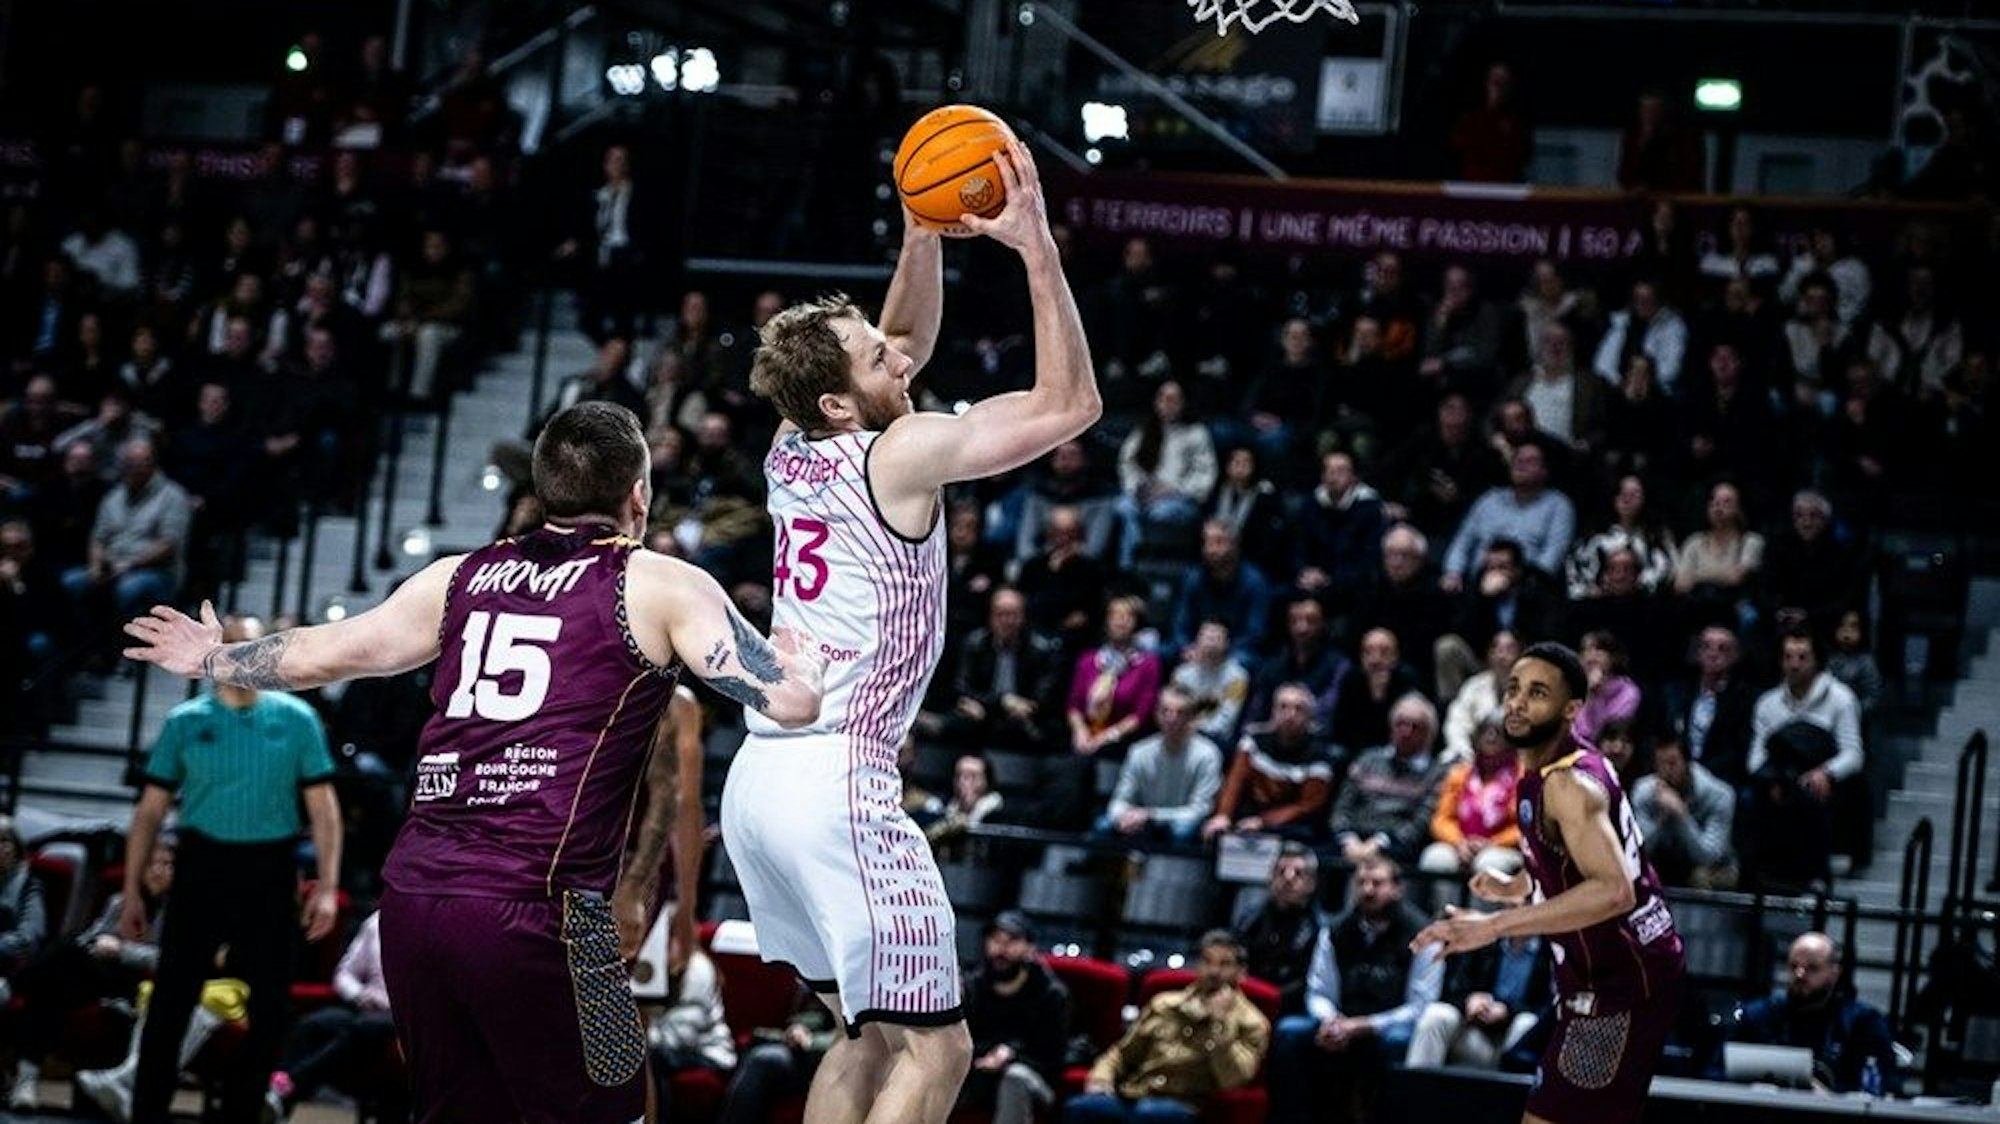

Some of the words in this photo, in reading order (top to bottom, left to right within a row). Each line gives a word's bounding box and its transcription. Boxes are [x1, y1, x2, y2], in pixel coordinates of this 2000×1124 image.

[1094, 200, 1231, 239] TERROIRS
[1260, 209, 1323, 244] UNE
[1327, 210, 1412, 249] MÊME
[1418, 216, 1549, 254] PASSION
[1580, 225, 1619, 258] 50
[465, 555, 600, 601] HROVAT
[774, 518, 829, 602] 43
[445, 610, 563, 722] 15
[474, 762, 558, 777] BOURGOGNE
[478, 778, 541, 793] FRANCHE
